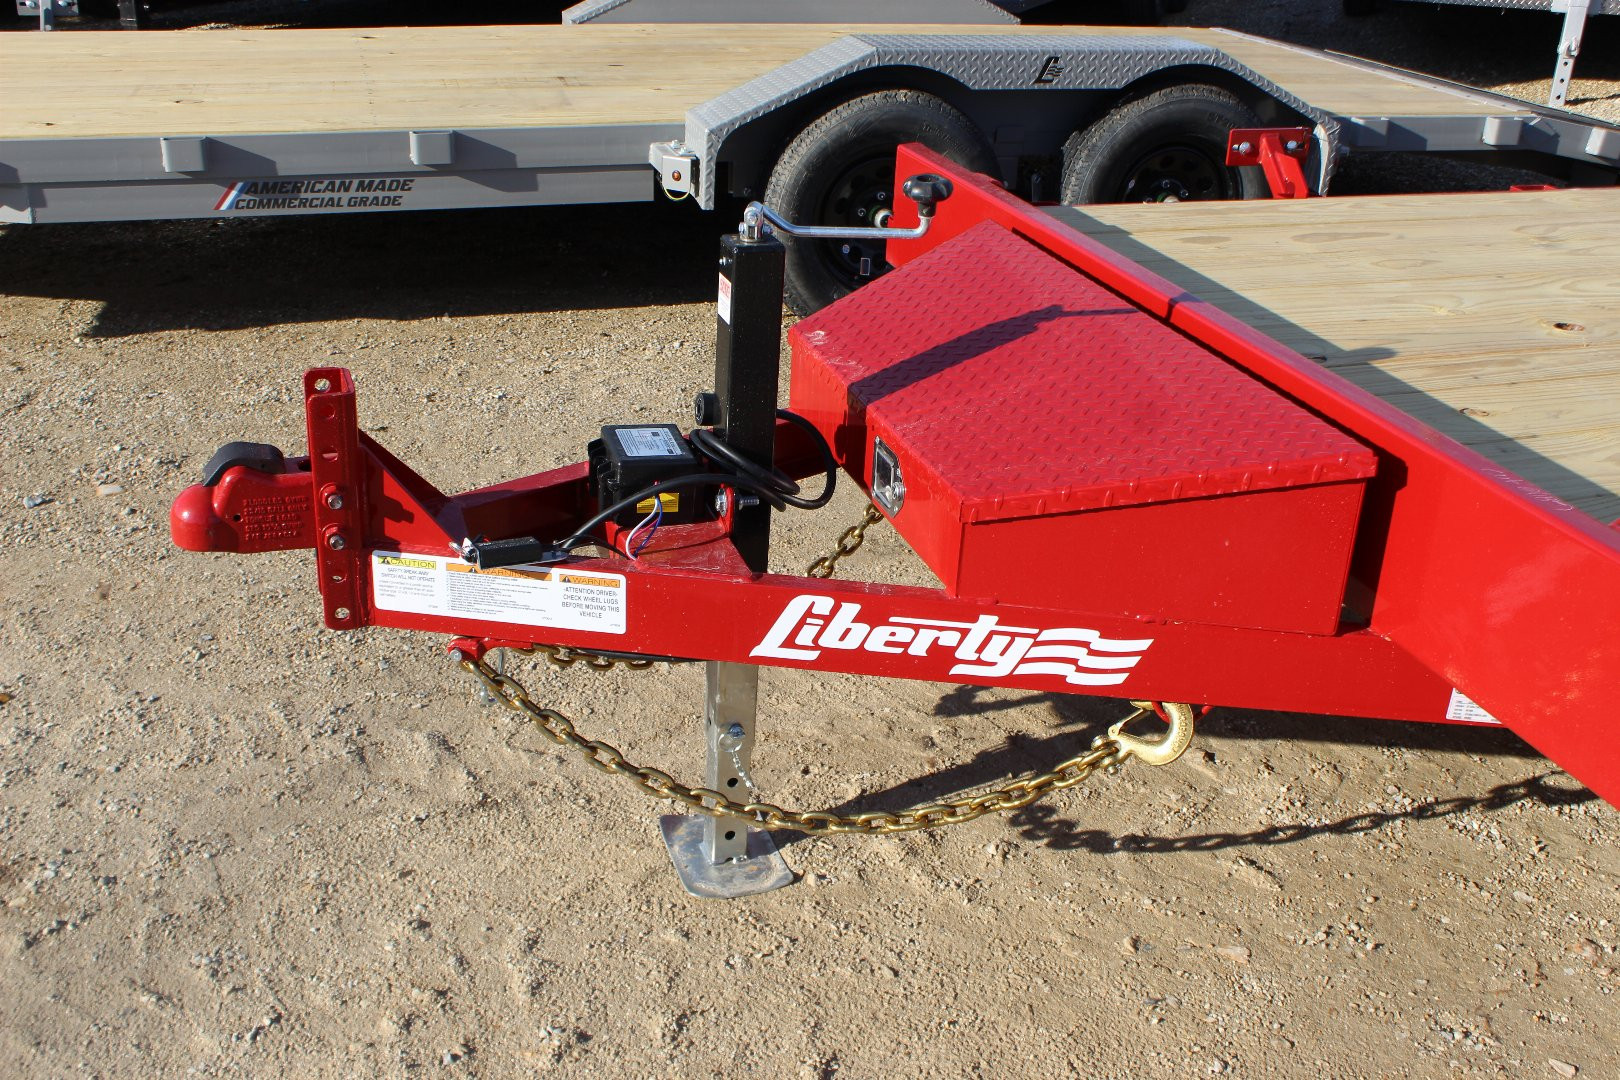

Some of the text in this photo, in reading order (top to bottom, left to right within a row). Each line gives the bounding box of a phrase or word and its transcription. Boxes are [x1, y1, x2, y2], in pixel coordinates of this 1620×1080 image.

[244, 178, 415, 195] AMERICAN MADE
[234, 195, 403, 210] COMMERCIAL GRADE
[390, 558, 435, 569] CAUTION
[572, 577, 618, 587] WARNING
[583, 595, 602, 604] WHEEL
[561, 601, 584, 609] BEFORE
[584, 603, 607, 612] MOVING
[579, 610, 603, 619] VEHICLE
[748, 594, 1039, 678] Liberty
